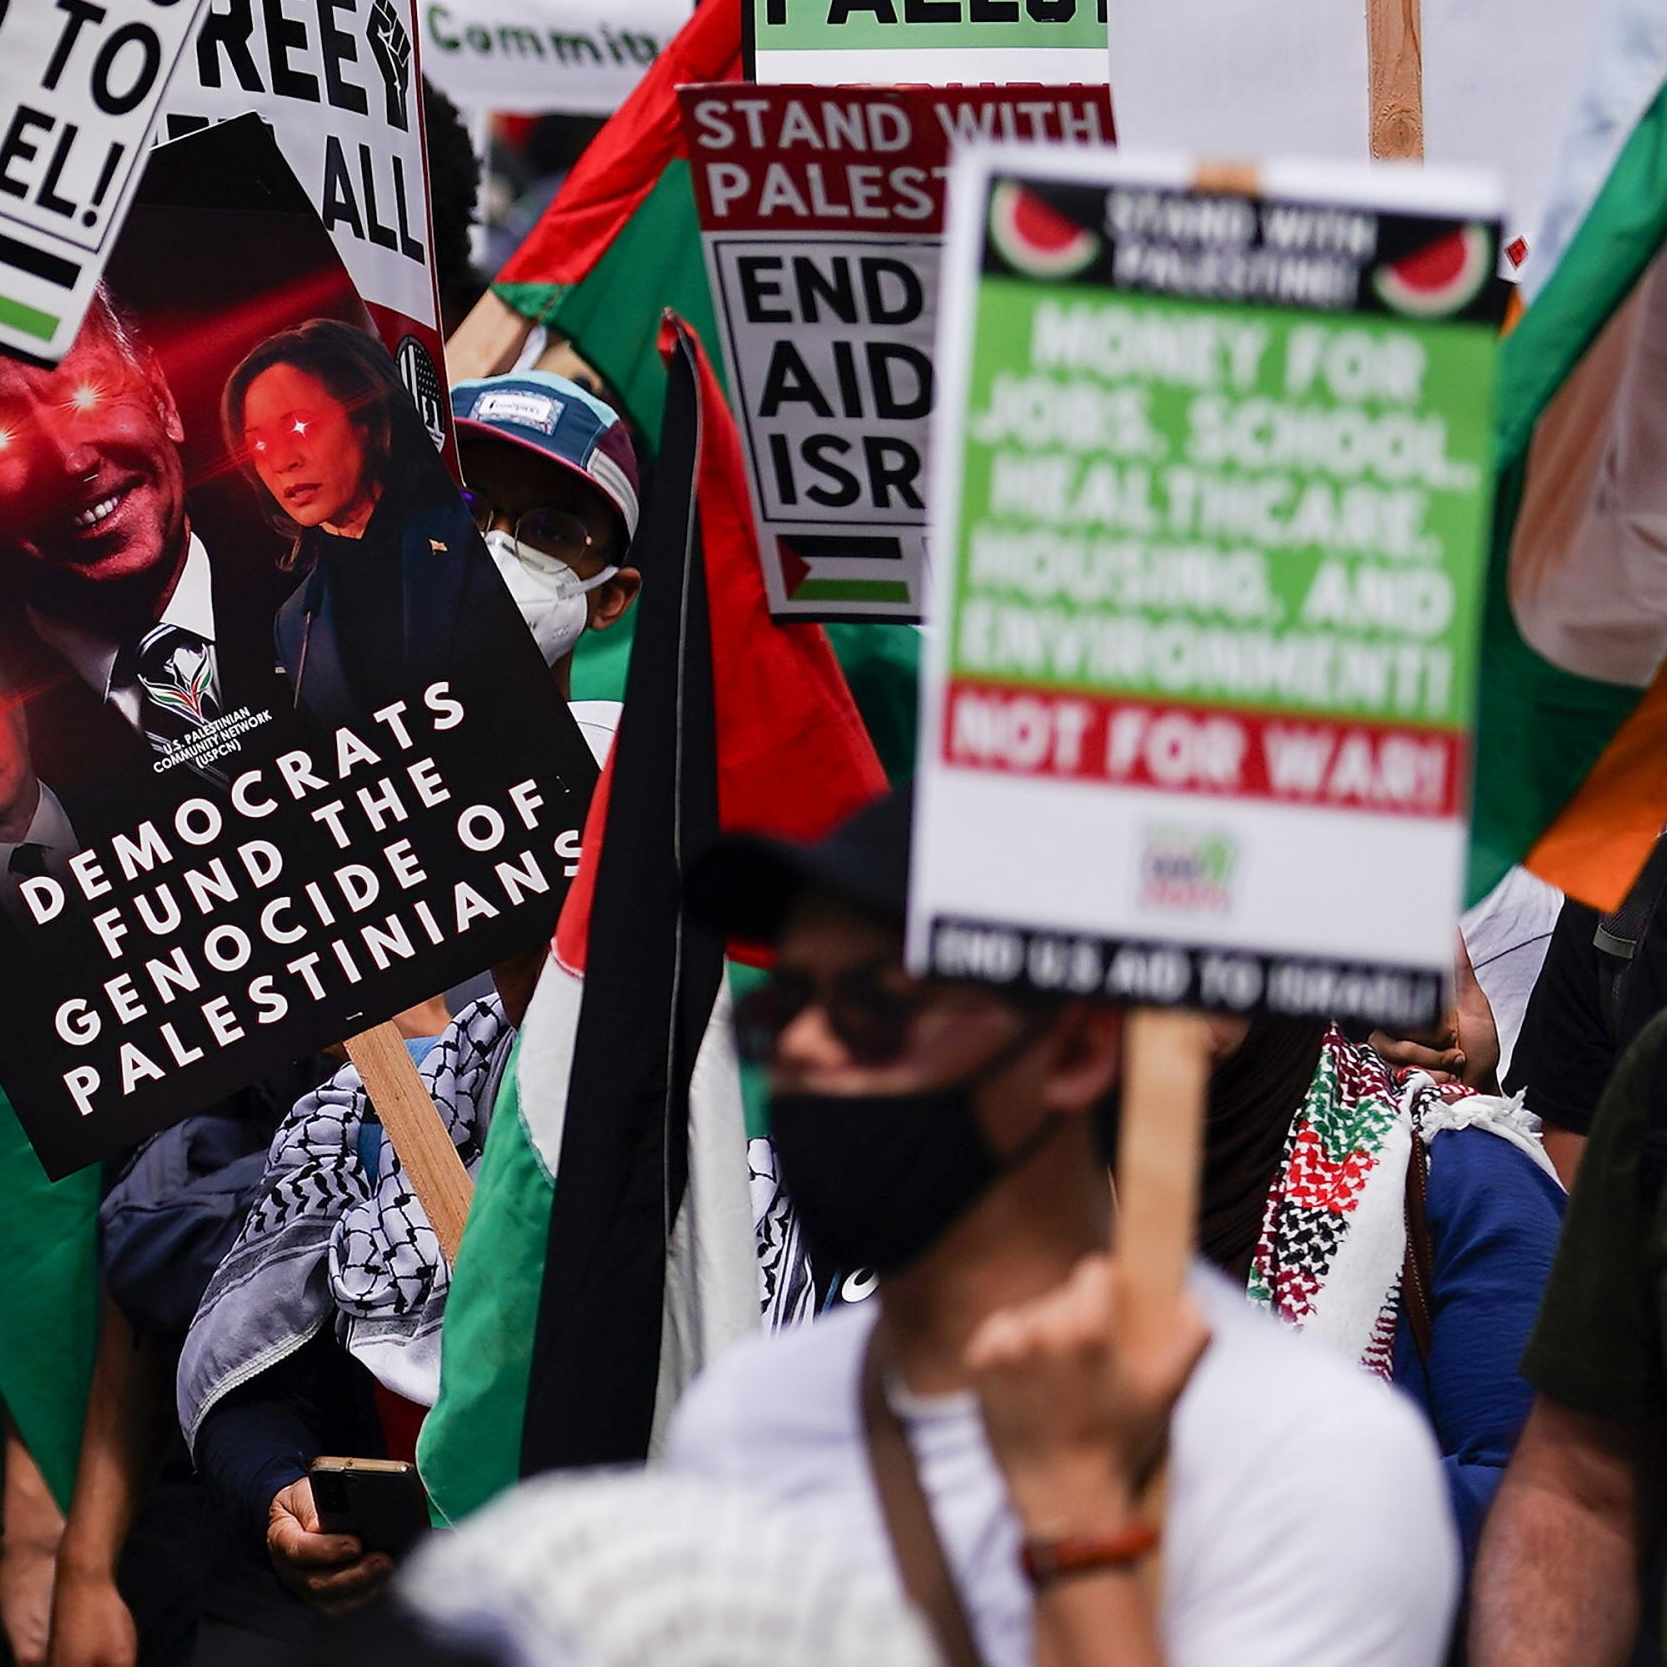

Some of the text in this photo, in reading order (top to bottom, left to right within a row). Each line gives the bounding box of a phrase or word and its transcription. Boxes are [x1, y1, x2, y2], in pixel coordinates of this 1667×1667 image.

[694, 99, 912, 152] STAND
[322, 135, 425, 266] ALL
[1105, 191, 1378, 254] STAND WITH
[736, 256, 925, 325] END
[1113, 239, 1359, 307] PALESTINE!
[759, 340, 934, 420] AID
[1029, 303, 1428, 403] MONEY FOR
[966, 522, 1457, 636] HOUSING, AND
[957, 602, 1455, 718] ENVIRONMENT!
[153, 710, 273, 773] COMMUNITY NETWORK
[163, 707, 251, 755] U.S. PALESTINIAN
[195, 739, 242, 769] (USPCN)
[947, 693, 1451, 808] NOT FOR WAR!
[18, 681, 465, 926] DEMOCRATS
[93, 757, 453, 960] FUND THE
[54, 778, 545, 1047] GENOCIDE OF
[63, 829, 583, 1116] PALESTINIANS
[932, 928, 1024, 984] END
[1106, 945, 1192, 1003] AID
[1198, 954, 1264, 1010] TO
